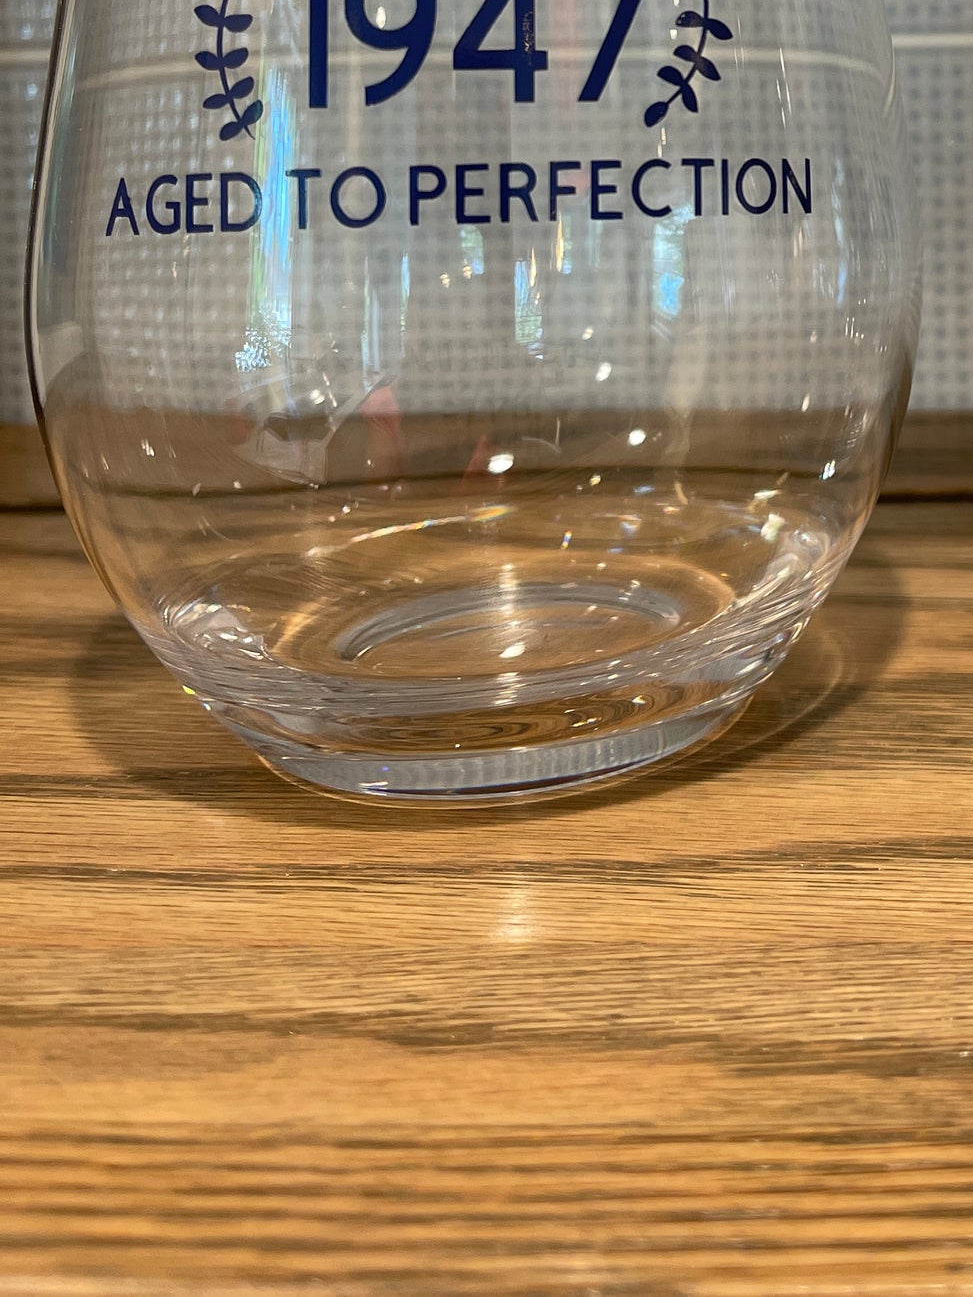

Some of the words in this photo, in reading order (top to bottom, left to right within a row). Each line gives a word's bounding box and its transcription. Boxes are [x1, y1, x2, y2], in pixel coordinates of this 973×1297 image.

[105, 173, 264, 237] AGED
[285, 167, 388, 230] TO
[409, 157, 814, 228] PERFECTION
